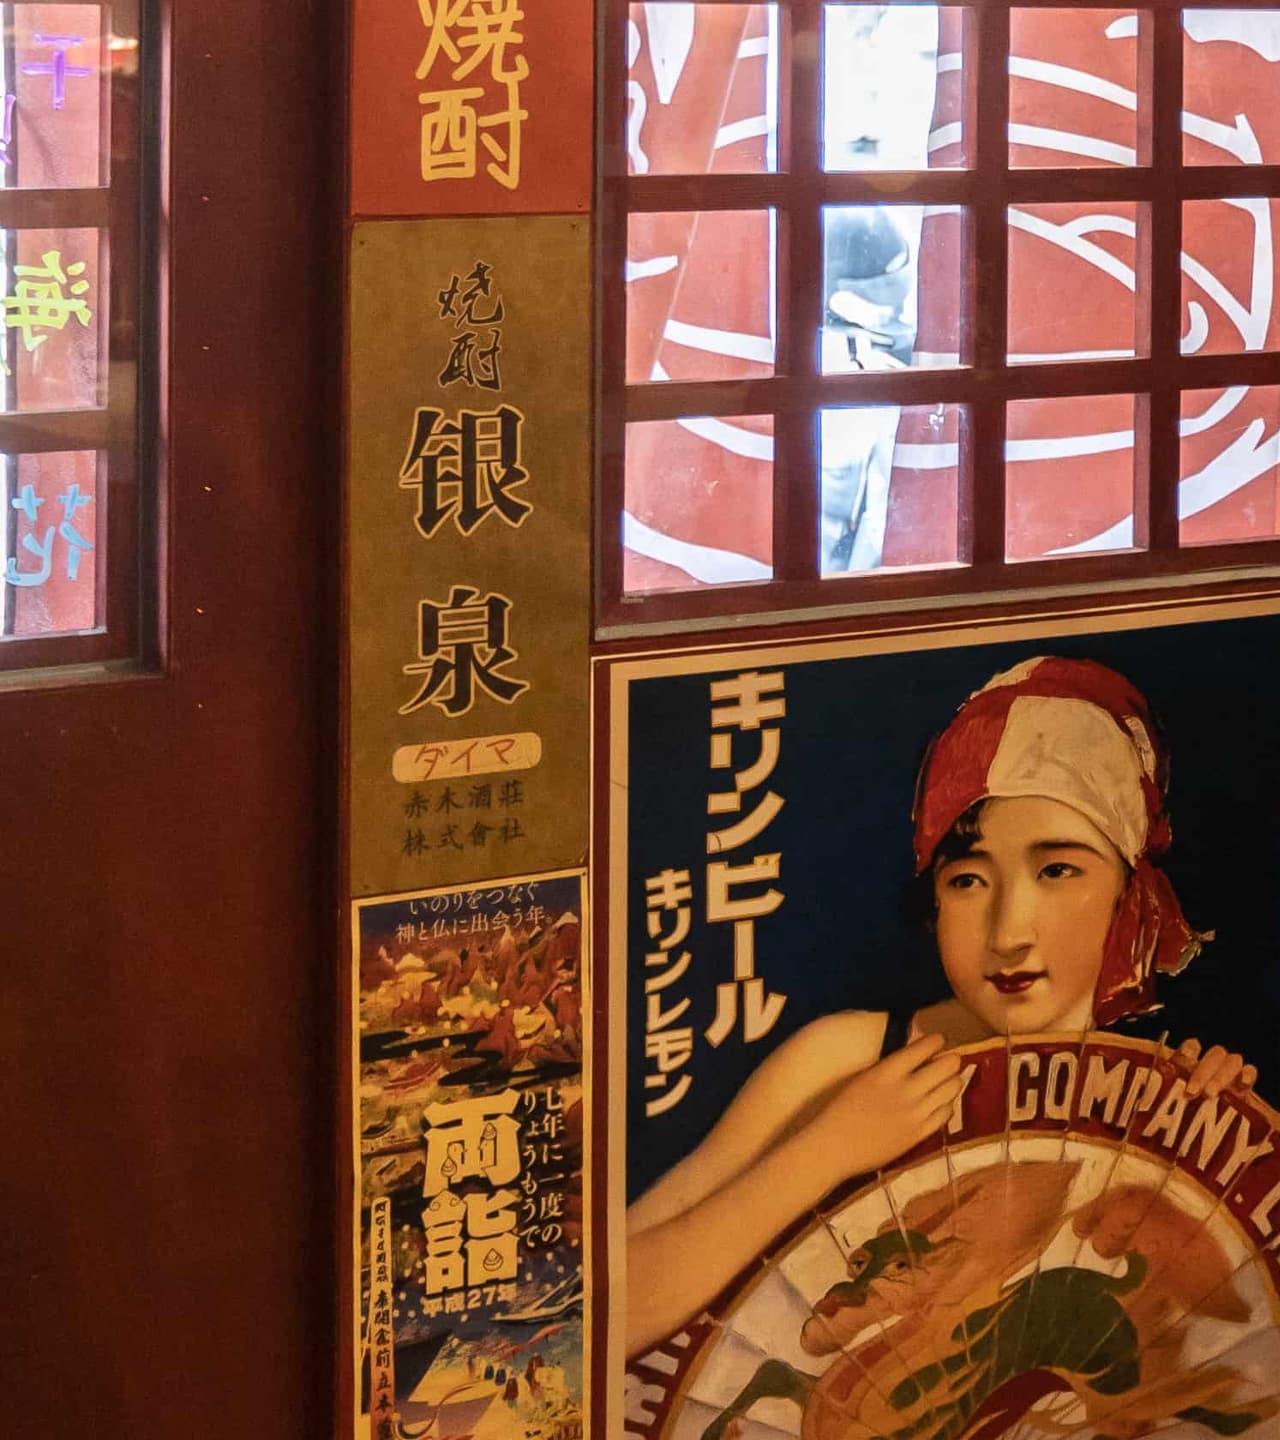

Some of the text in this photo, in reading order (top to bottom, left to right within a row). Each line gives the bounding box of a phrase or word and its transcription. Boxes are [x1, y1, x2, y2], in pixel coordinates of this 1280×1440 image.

[414, 735, 518, 780] ダイマ
[409, 882, 539, 915] いのりをつなぐ
[705, 671, 786, 1048] キリンビール
[644, 868, 694, 1118] キリンレモン
